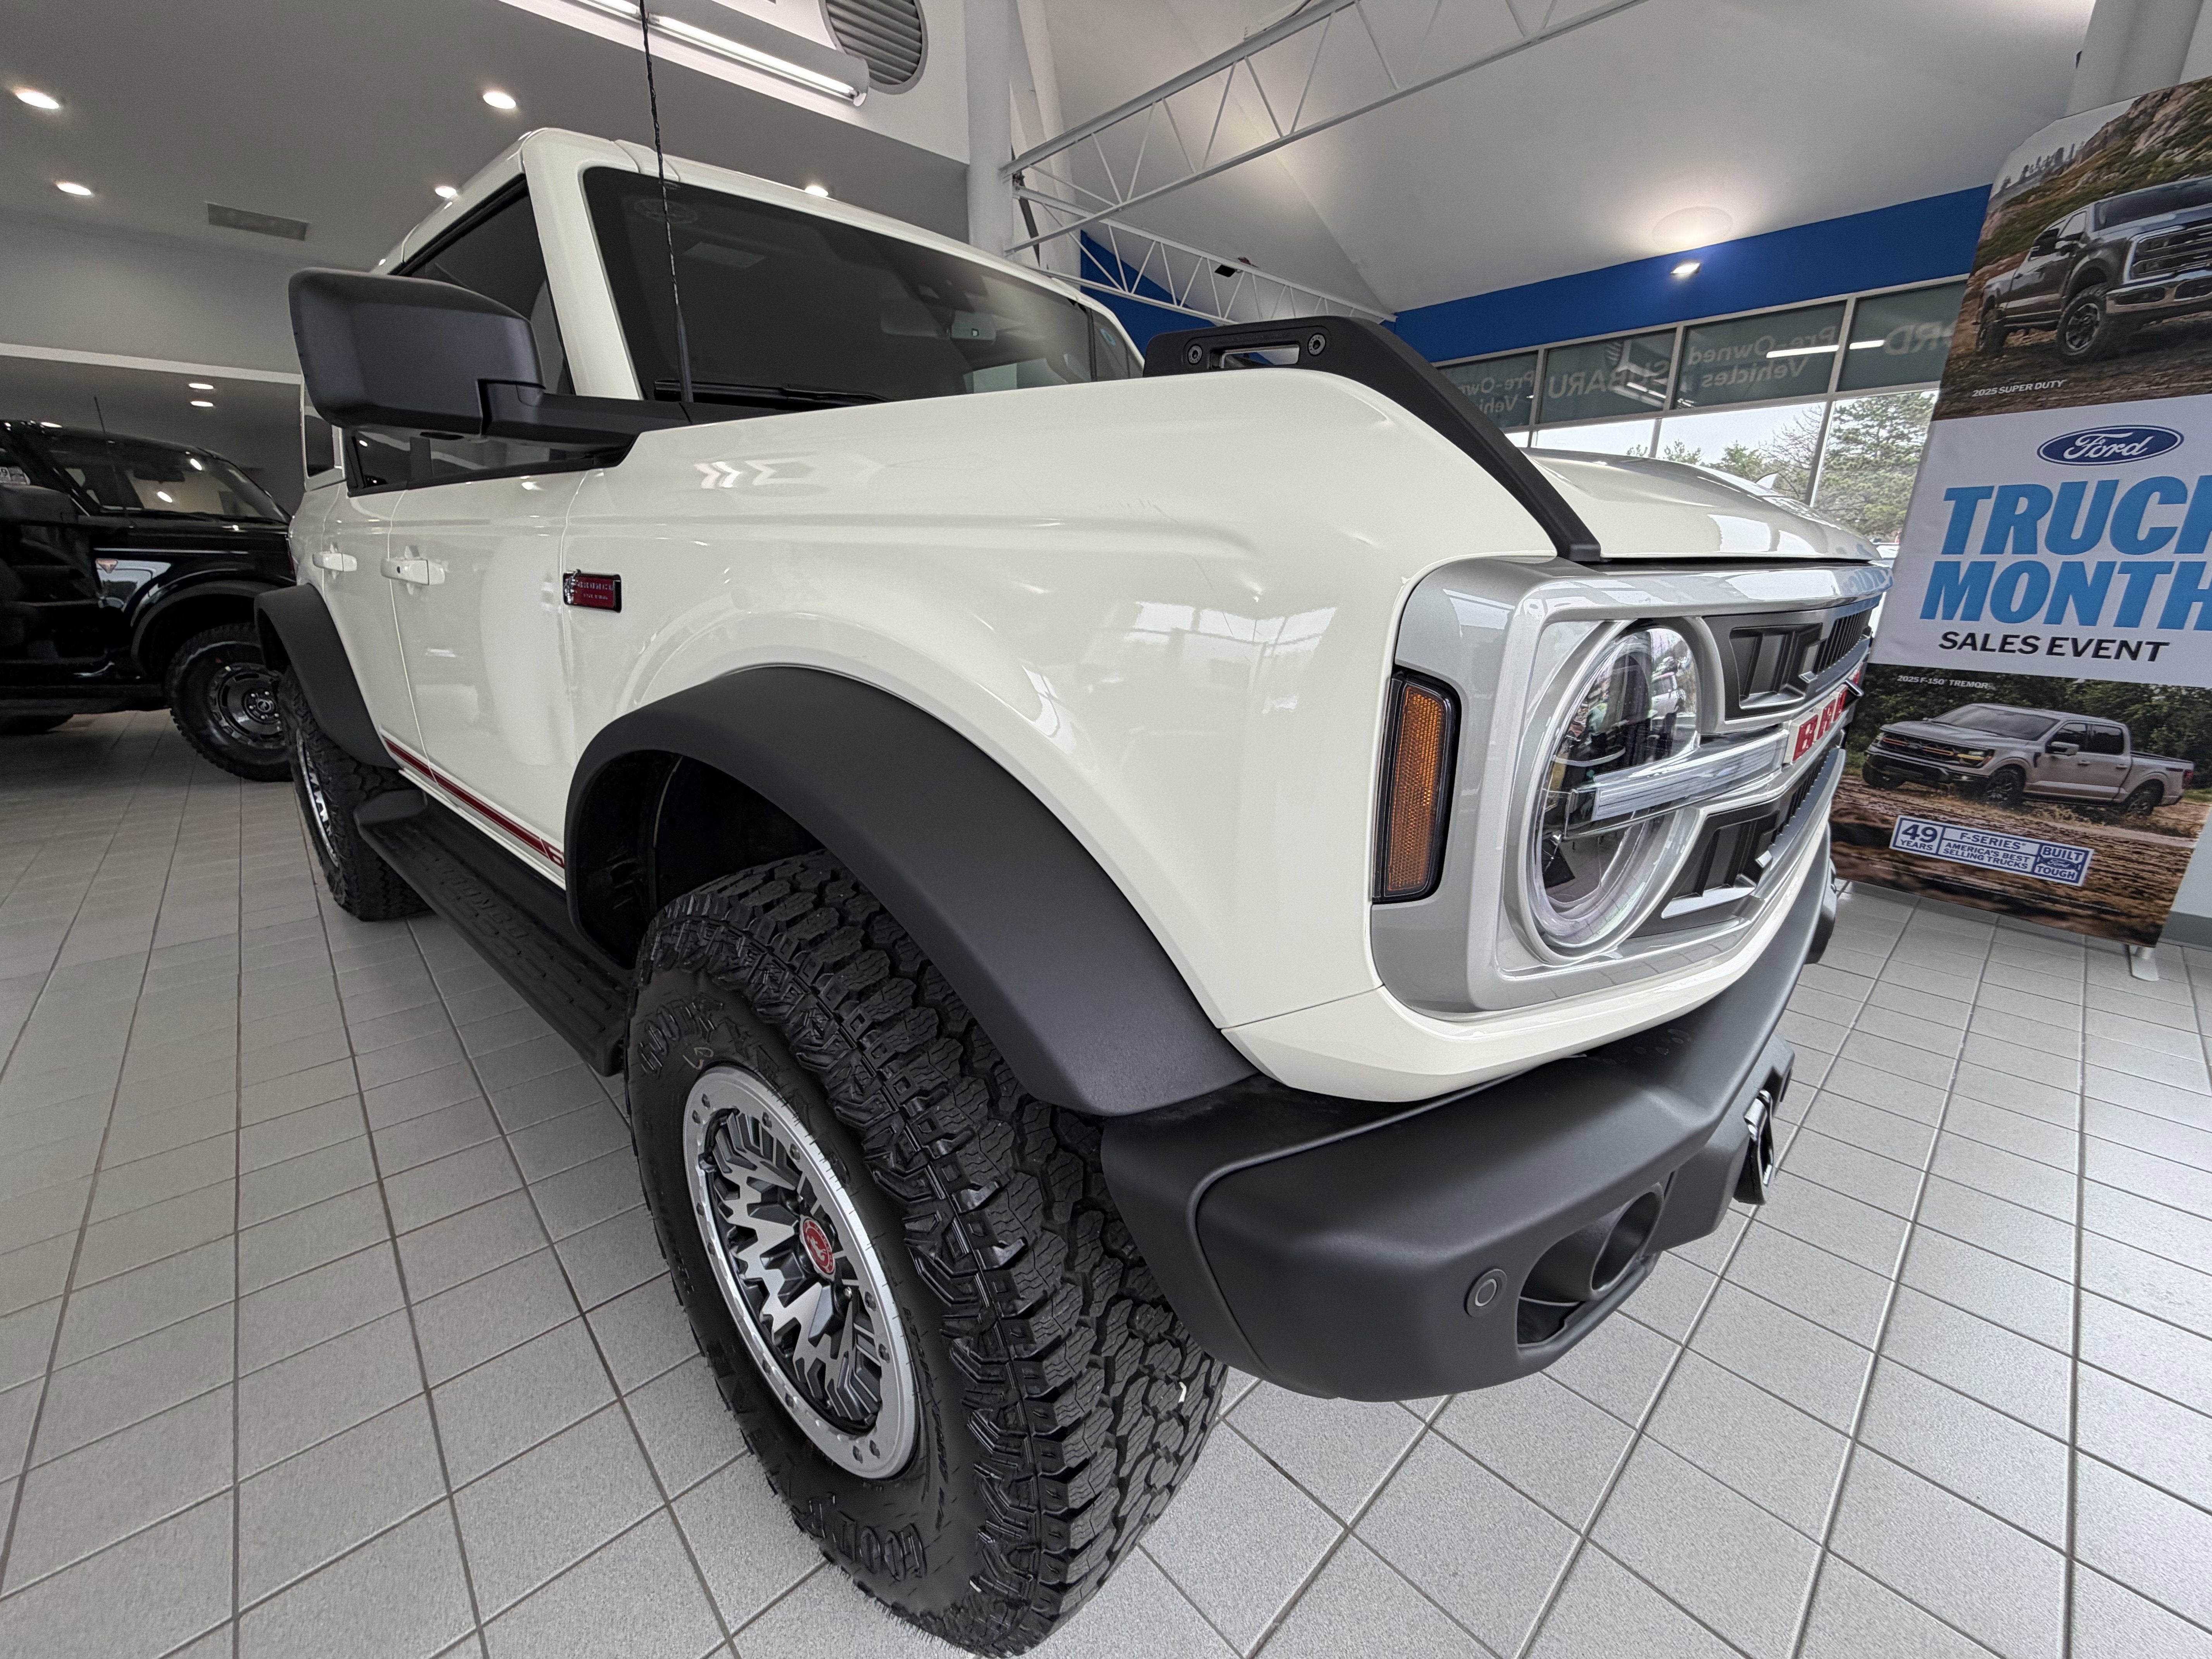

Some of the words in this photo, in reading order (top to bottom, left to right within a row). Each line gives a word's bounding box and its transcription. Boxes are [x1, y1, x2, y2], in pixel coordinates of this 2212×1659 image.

[1972, 388, 1998, 397] 2025
[1998, 383, 2033, 395] SUPER
[2034, 380, 2066, 390] DUTY
[2063, 432, 2155, 459] Ford
[1919, 560, 2212, 631] MONTH
[1938, 631, 2041, 655] SALES
[2045, 636, 2171, 662] EVENT
[1949, 679, 1989, 689] TREMOR
[1901, 824, 1938, 843] 49
[1900, 839, 1933, 851] YEARS
[1945, 842, 1999, 857] AMERICA'S
[2002, 852, 2030, 863] BEST
[2042, 847, 2083, 861] BUILT
[1942, 848, 1984, 861] SELLING
[1987, 856, 2028, 869] TRUCKS
[2037, 866, 2076, 879] TOUGH
